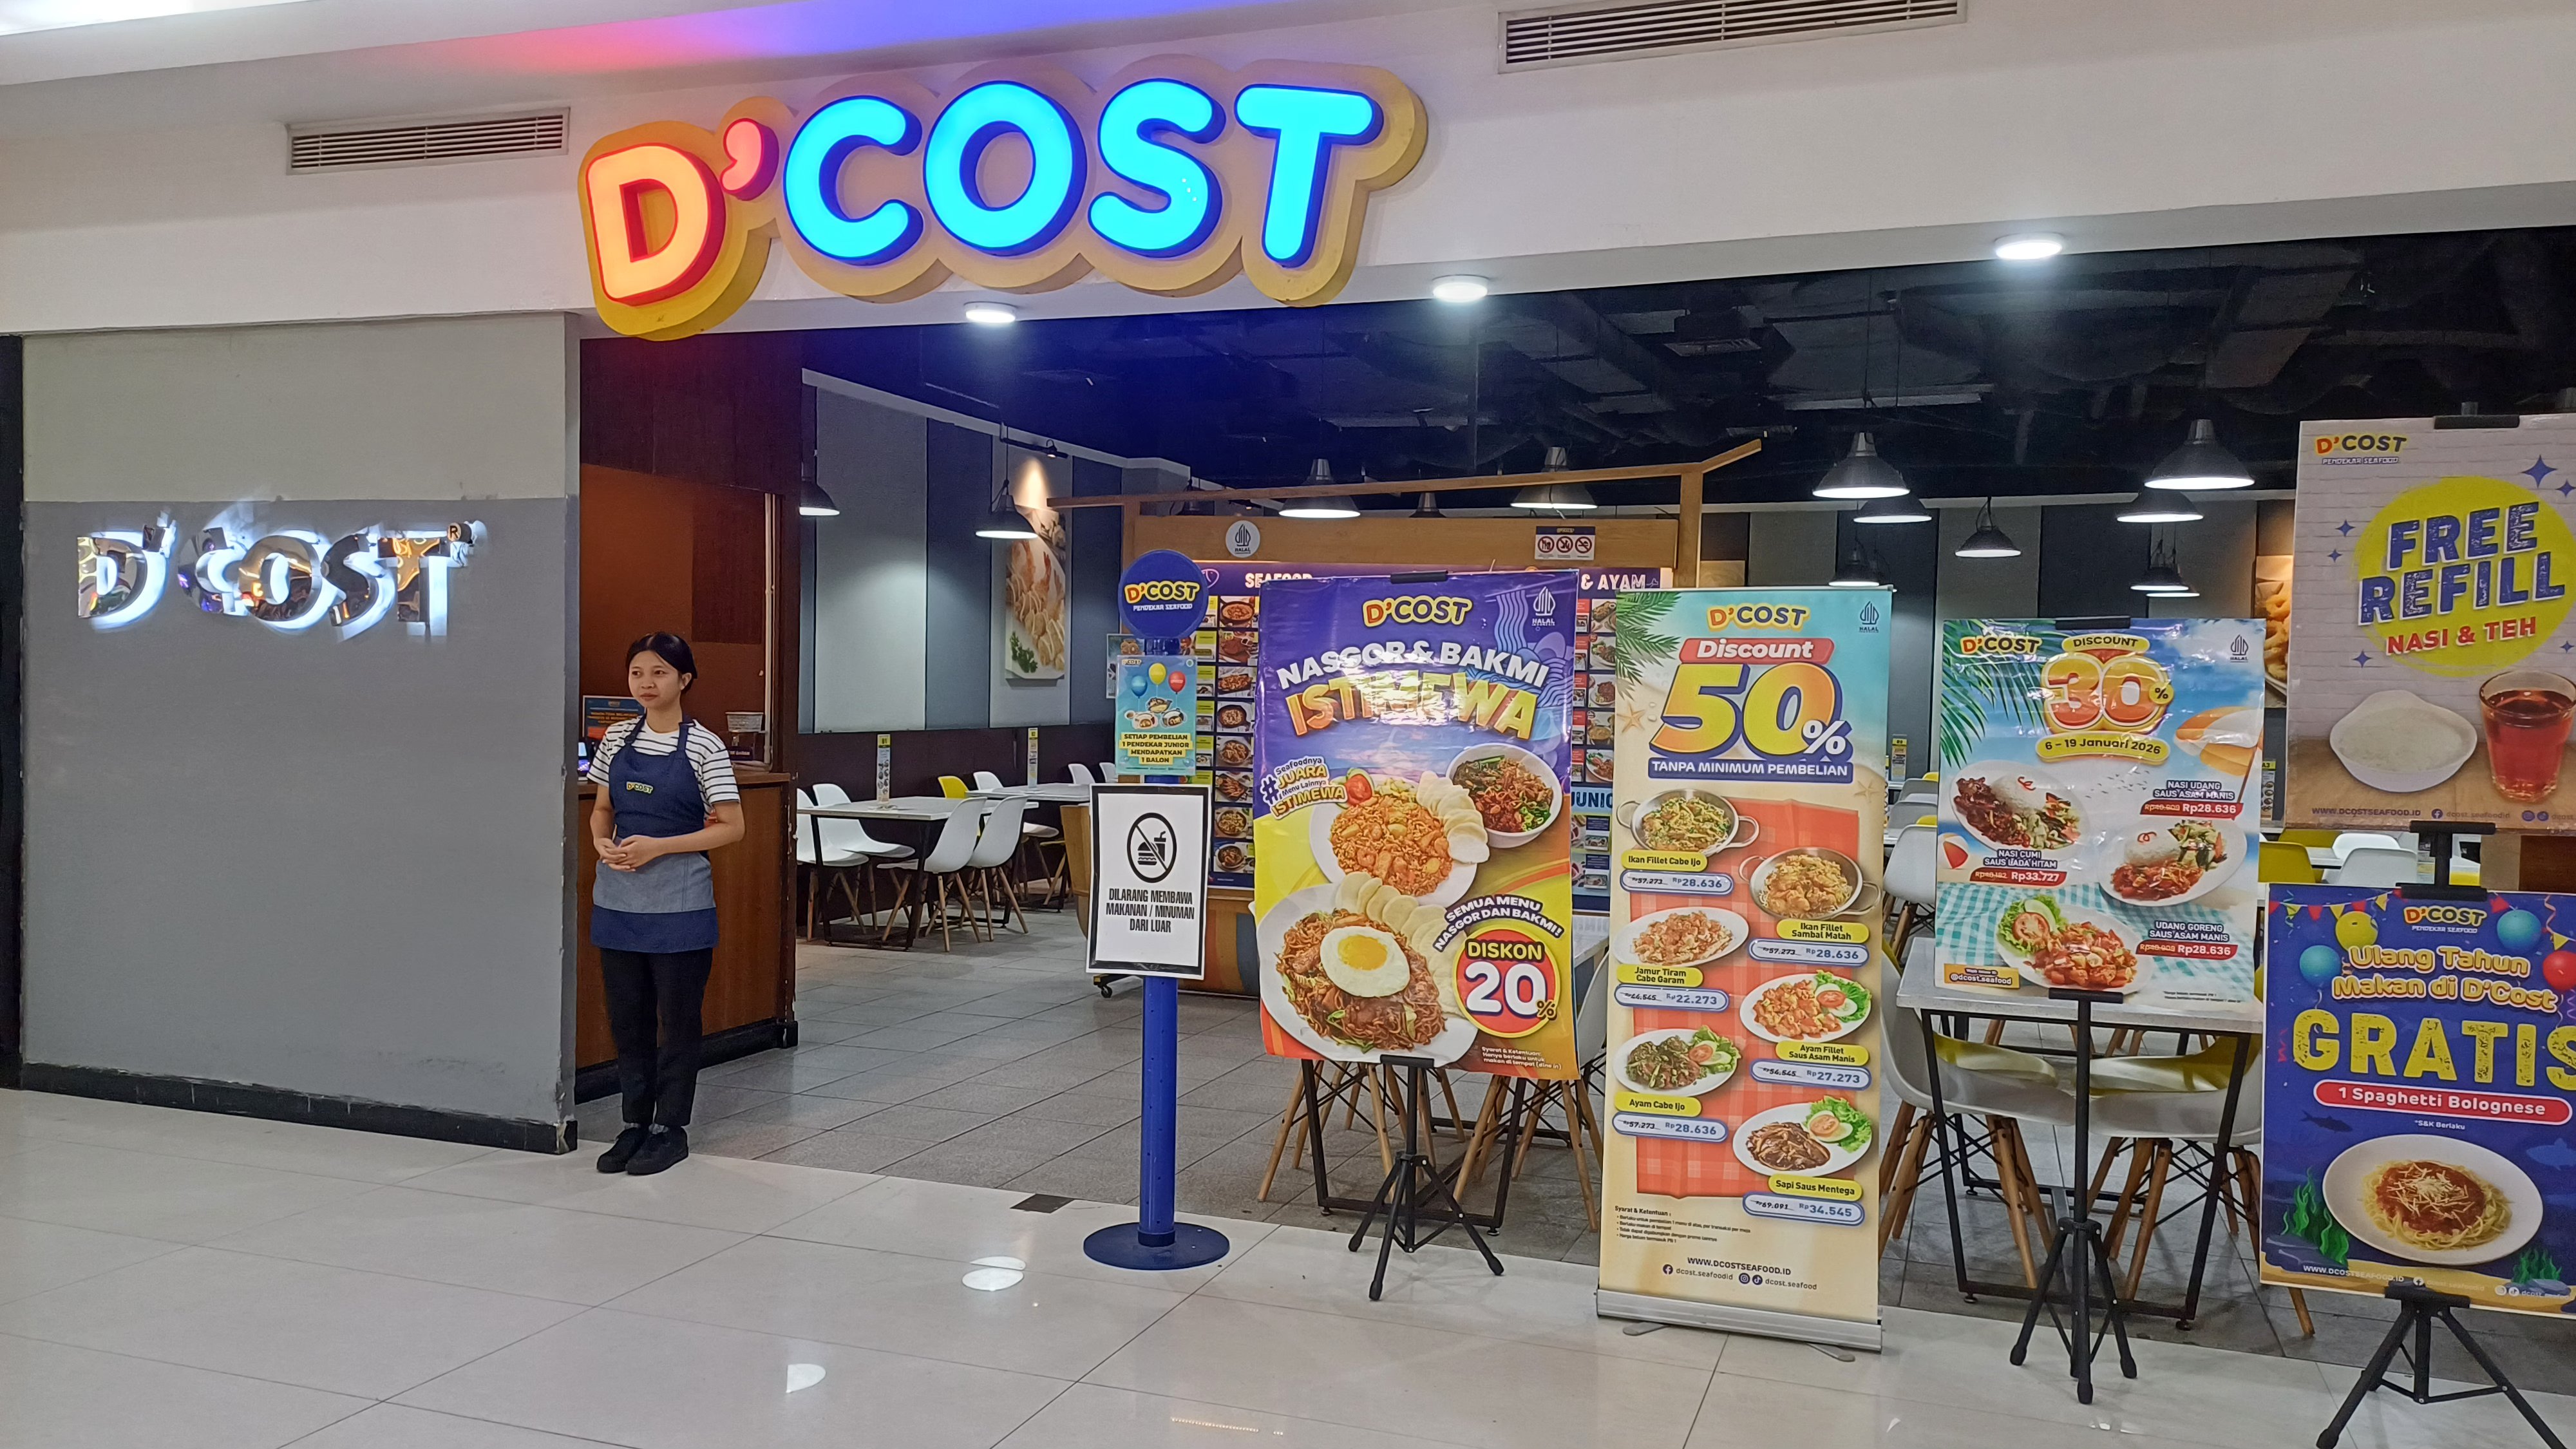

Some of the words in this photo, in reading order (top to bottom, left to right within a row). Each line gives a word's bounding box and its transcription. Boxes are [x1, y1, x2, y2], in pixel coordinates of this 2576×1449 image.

[585, 78, 1383, 305] D'COST
[2316, 435, 2407, 454] D'COST
[2387, 502, 2539, 571] FREE
[77, 522, 448, 626] D'COST
[1581, 574, 1593, 590] &
[1597, 574, 1645, 589] AYAM
[1126, 582, 1198, 602] D'COST
[2358, 552, 2565, 626] REFILL
[1365, 598, 1470, 625] D'COST
[1709, 605, 1807, 627] D'COST
[2073, 636, 2139, 648] DISCOUNT
[2386, 629, 2448, 656] NASI
[2457, 626, 2476, 645] &
[2485, 617, 2536, 642] TEH
[1697, 638, 1814, 658] Discount
[1962, 636, 2041, 654] D'COST
[1277, 641, 1405, 689] NASGOR
[1414, 641, 1434, 664] &
[1440, 642, 1549, 688] BAKMI
[2045, 742, 2052, 750] 6
[2065, 739, 2077, 748] 19
[2079, 739, 2128, 749] Januari
[2132, 741, 2161, 754] 2026
[1276, 757, 1322, 775] Seafoodnya
[1652, 761, 1696, 773] TANPA
[1698, 761, 1764, 774] MINIMUM
[1768, 763, 1848, 777] PEMBELIAN
[1278, 764, 1327, 789] JUARA
[627, 782, 653, 793] D'COST
[1271, 786, 1345, 817] ISTIMEWA
[2183, 803, 2236, 814] Rp28.636
[2311, 807, 2421, 816] WWW.DCOSTSEAFOOD.ID
[1691, 858, 1701, 867] Ijo
[1672, 877, 1722, 888] Rp28.636
[2011, 871, 2060, 882] Rp33.727
[1109, 888, 1148, 902] DILARANG
[1150, 890, 1193, 904] MEMBAWA
[1106, 903, 1147, 917] MAKANAN
[1150, 904, 1153, 917] /
[1155, 905, 1195, 920] MINUMAN
[1446, 896, 1494, 922] SEMUA
[1496, 896, 1540, 911] MENU
[2404, 907, 2485, 925] D'COST
[1130, 918, 1148, 931] DARI
[1151, 920, 1171, 933] LUAR
[1434, 912, 1484, 951] NASGOR
[1483, 907, 1511, 920] DAN
[1512, 909, 1564, 936] BAKMI!
[2155, 922, 2185, 930] UDANG
[2188, 923, 2222, 932] GORENG
[1792, 930, 1823, 938] Sambal
[2174, 932, 2198, 940] ASAM
[1467, 942, 1542, 960] DISKON
[1806, 948, 1859, 959] Rp28.636
[2177, 944, 2231, 956] Rp28.636
[2349, 947, 2434, 971] Ulang
[2439, 947, 2530, 976] Tahun
[1634, 967, 1660, 975] Jamur
[1662, 968, 1686, 976] Tiram
[1658, 976, 1685, 984] Garam
[1667, 993, 1717, 1005] Rp22.273
[2333, 974, 2425, 998] Makan
[2431, 976, 2457, 998] di
[2463, 978, 2557, 1011] D'Cost
[1800, 1045, 1821, 1054] Ayam
[2293, 1009, 2576, 1091] GRATIS
[1808, 1053, 1830, 1061] Asam
[1832, 1054, 1855, 1063] Manis
[1806, 1070, 1860, 1083] Rp27.273
[1629, 1099, 1652, 1108] Ayam
[1675, 1103, 1685, 1111] Ijo
[2339, 1087, 2346, 1099] 1
[2352, 1088, 2441, 1106] Spaghetti
[2448, 1096, 2546, 1115] Bolognese
[1665, 1122, 1716, 1135] Rp28.636
[2436, 1121, 2465, 1130] Berlaku
[1776, 1180, 1794, 1189] Sapi
[1795, 1182, 1816, 1191] Saus
[1818, 1184, 1855, 1195] Mentega
[1799, 1202, 1852, 1217] Rp34.545
[1687, 1256, 1791, 1275] WWW.DCOSTSEAFOOD.ID
[2304, 1265, 2404, 1282] WWW.DCOSTSEAFOOD.ID
